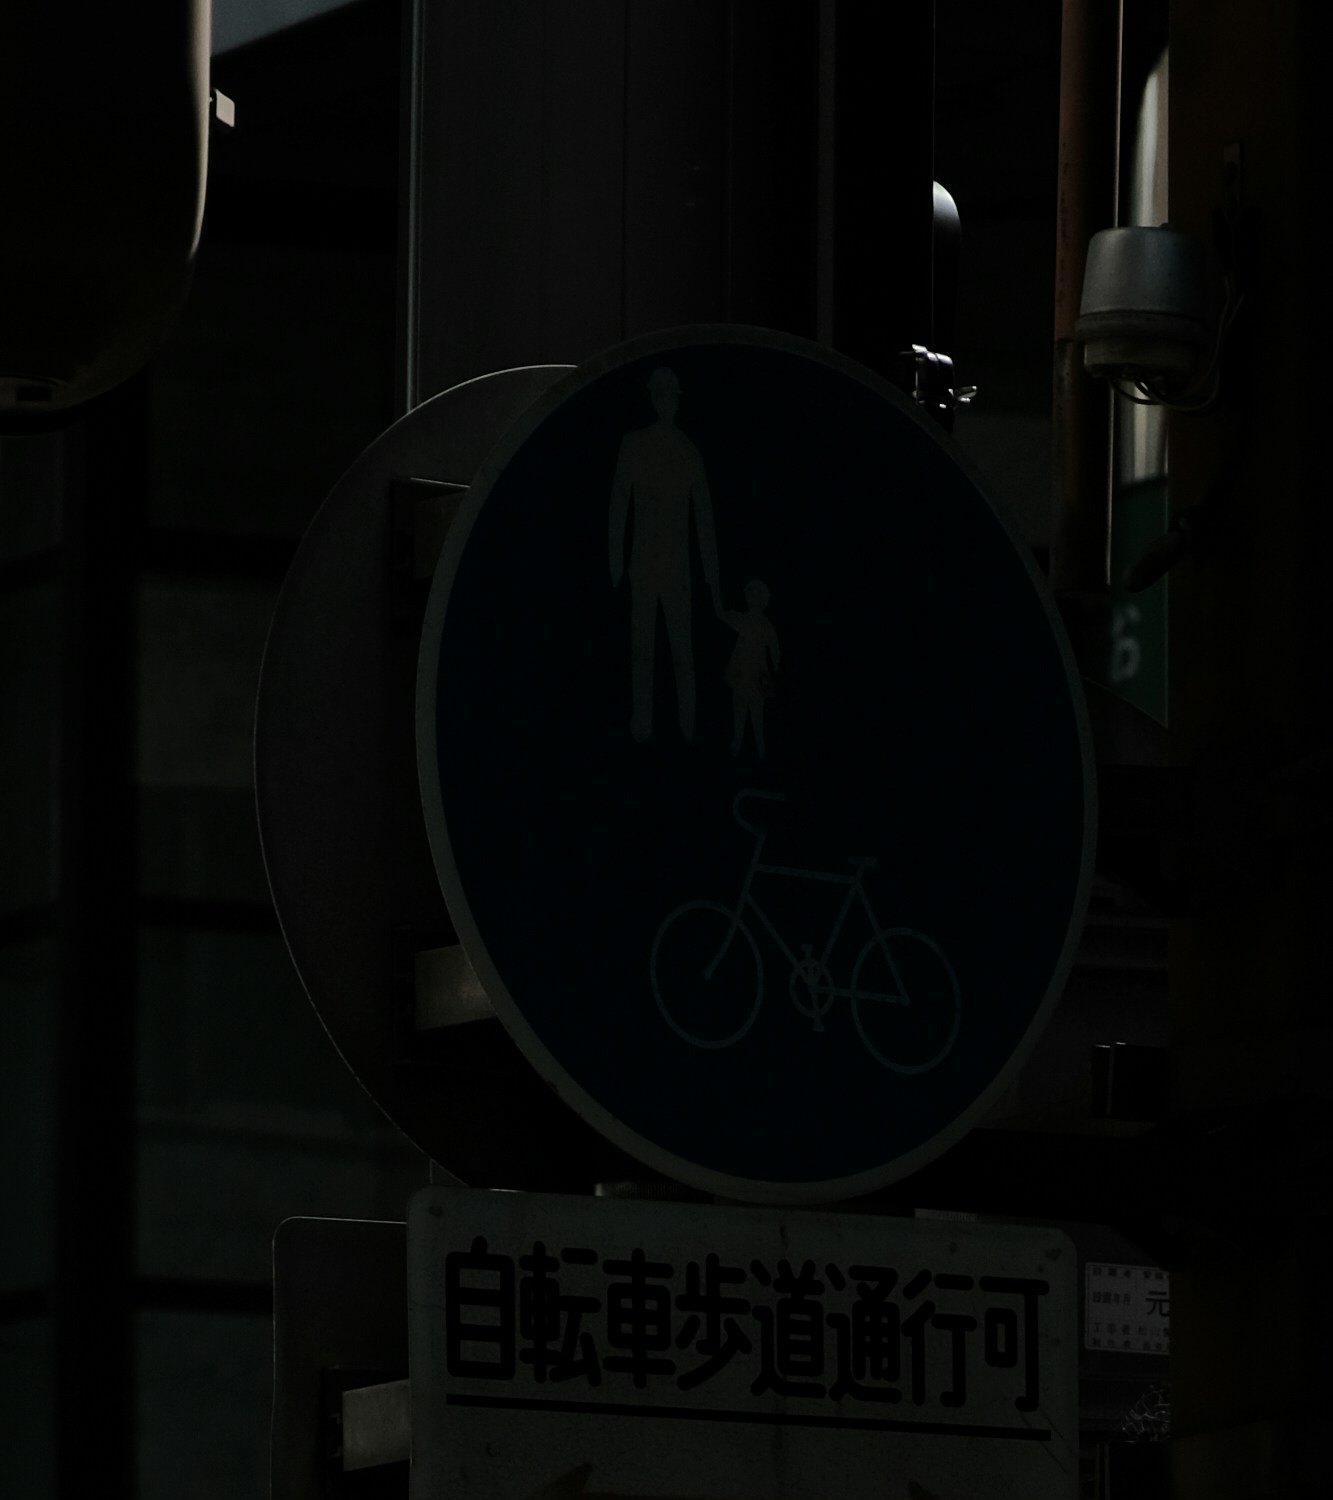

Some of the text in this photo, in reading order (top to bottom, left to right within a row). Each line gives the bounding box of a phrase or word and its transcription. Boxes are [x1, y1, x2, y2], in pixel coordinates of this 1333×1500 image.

[445, 1235, 1050, 1413] 自転車歩道通行可
